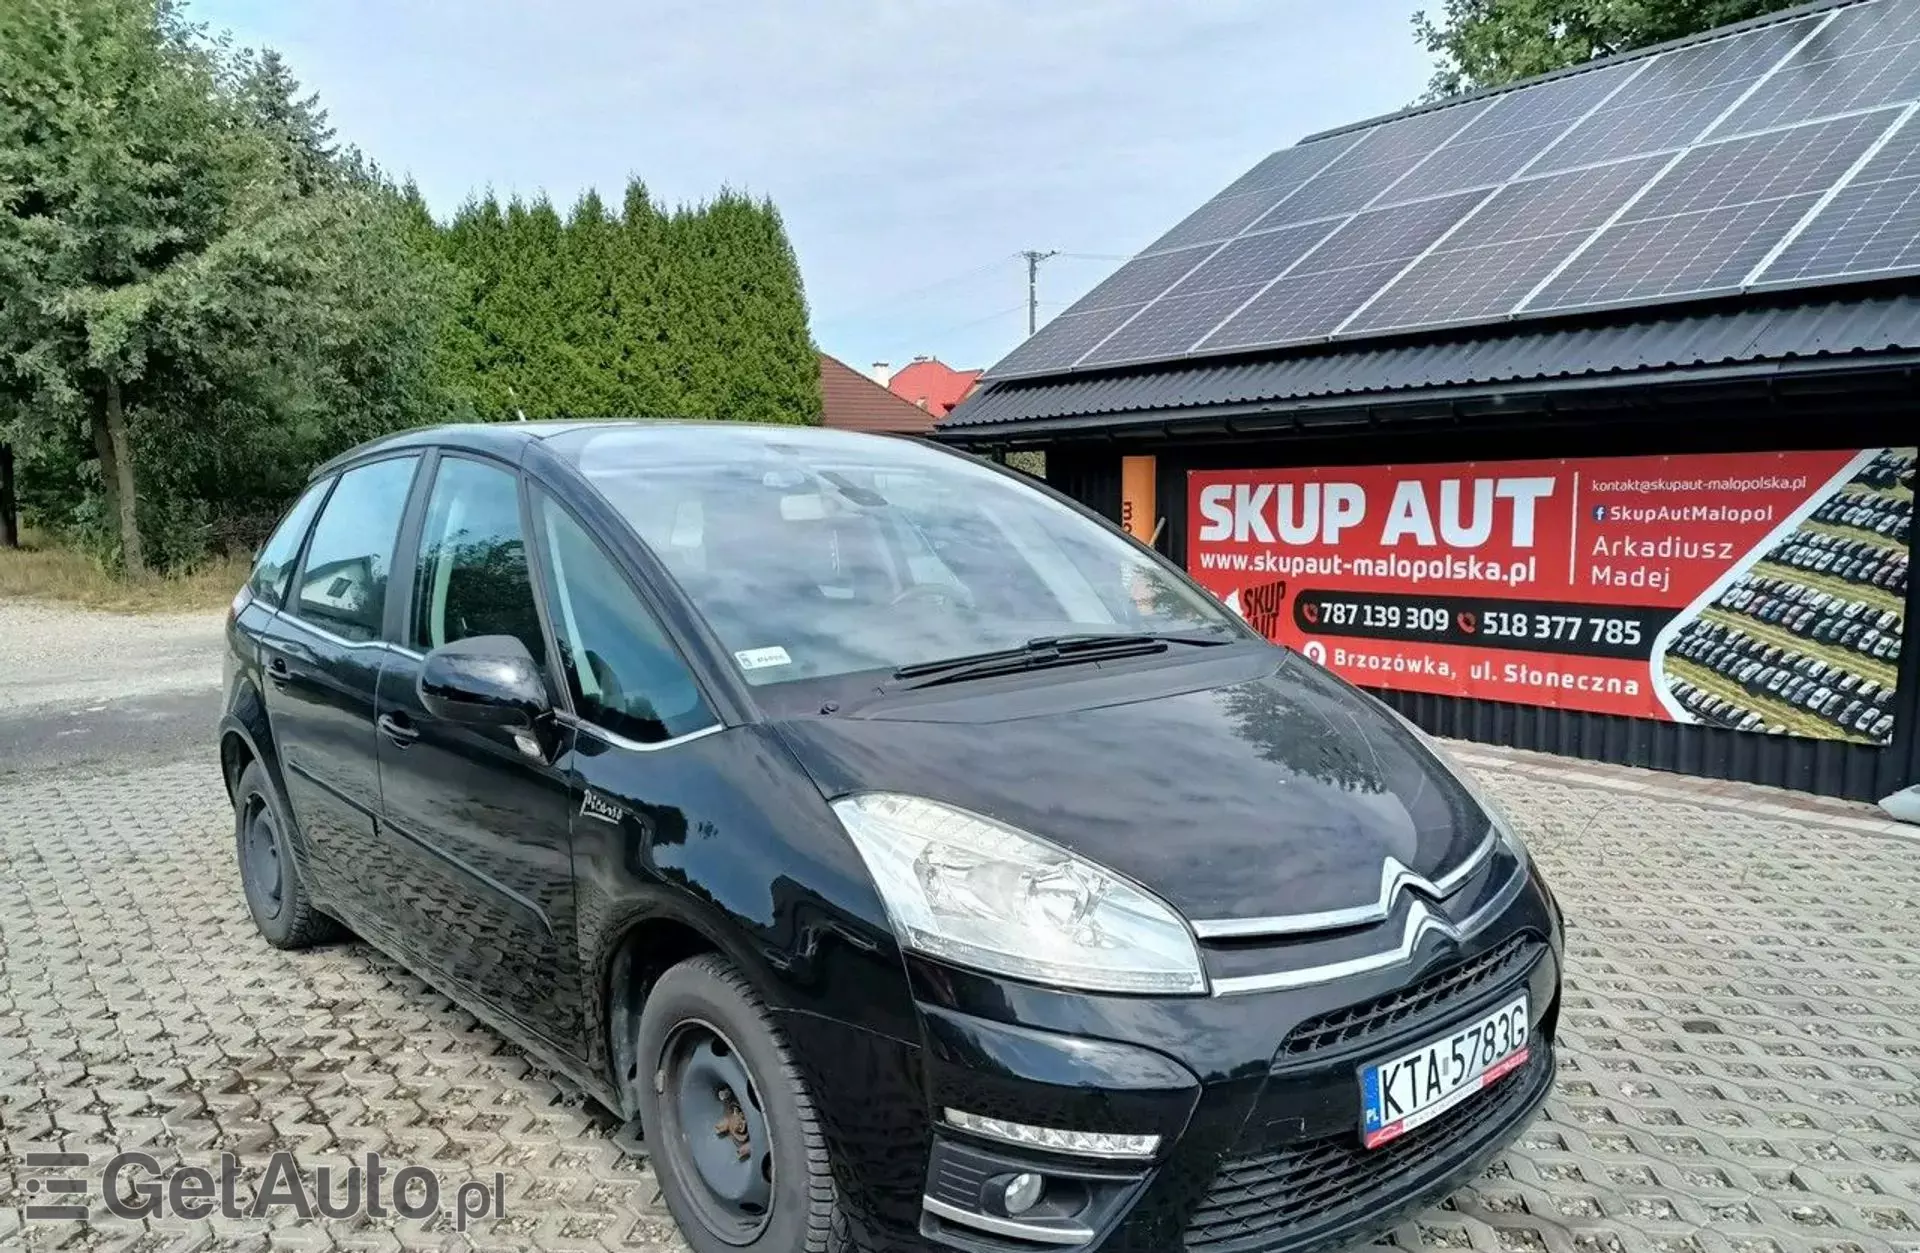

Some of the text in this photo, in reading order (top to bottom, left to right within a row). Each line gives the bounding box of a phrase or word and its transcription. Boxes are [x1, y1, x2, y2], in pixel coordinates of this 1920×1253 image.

[1592, 476, 1806, 494] kontakt@skupaut-malopolska.pl
[1200, 477, 1556, 547] SKUP AUT
[1610, 505, 1773, 523] SkupAutMalopol
[1592, 535, 1733, 559] Arkadiusz
[1200, 550, 1536, 587] www.skupaut-malopolska.pl
[1591, 566, 1670, 592] Madej
[1244, 581, 1286, 618] SKUP
[1320, 602, 1449, 631] 787 139 309
[1483, 612, 1641, 645] 518 377 785
[1335, 648, 1639, 696] Brzozówka, ul. Słoneczna
[1382, 1048, 1442, 1120] KTA
[1451, 1005, 1526, 1086] 5783G
